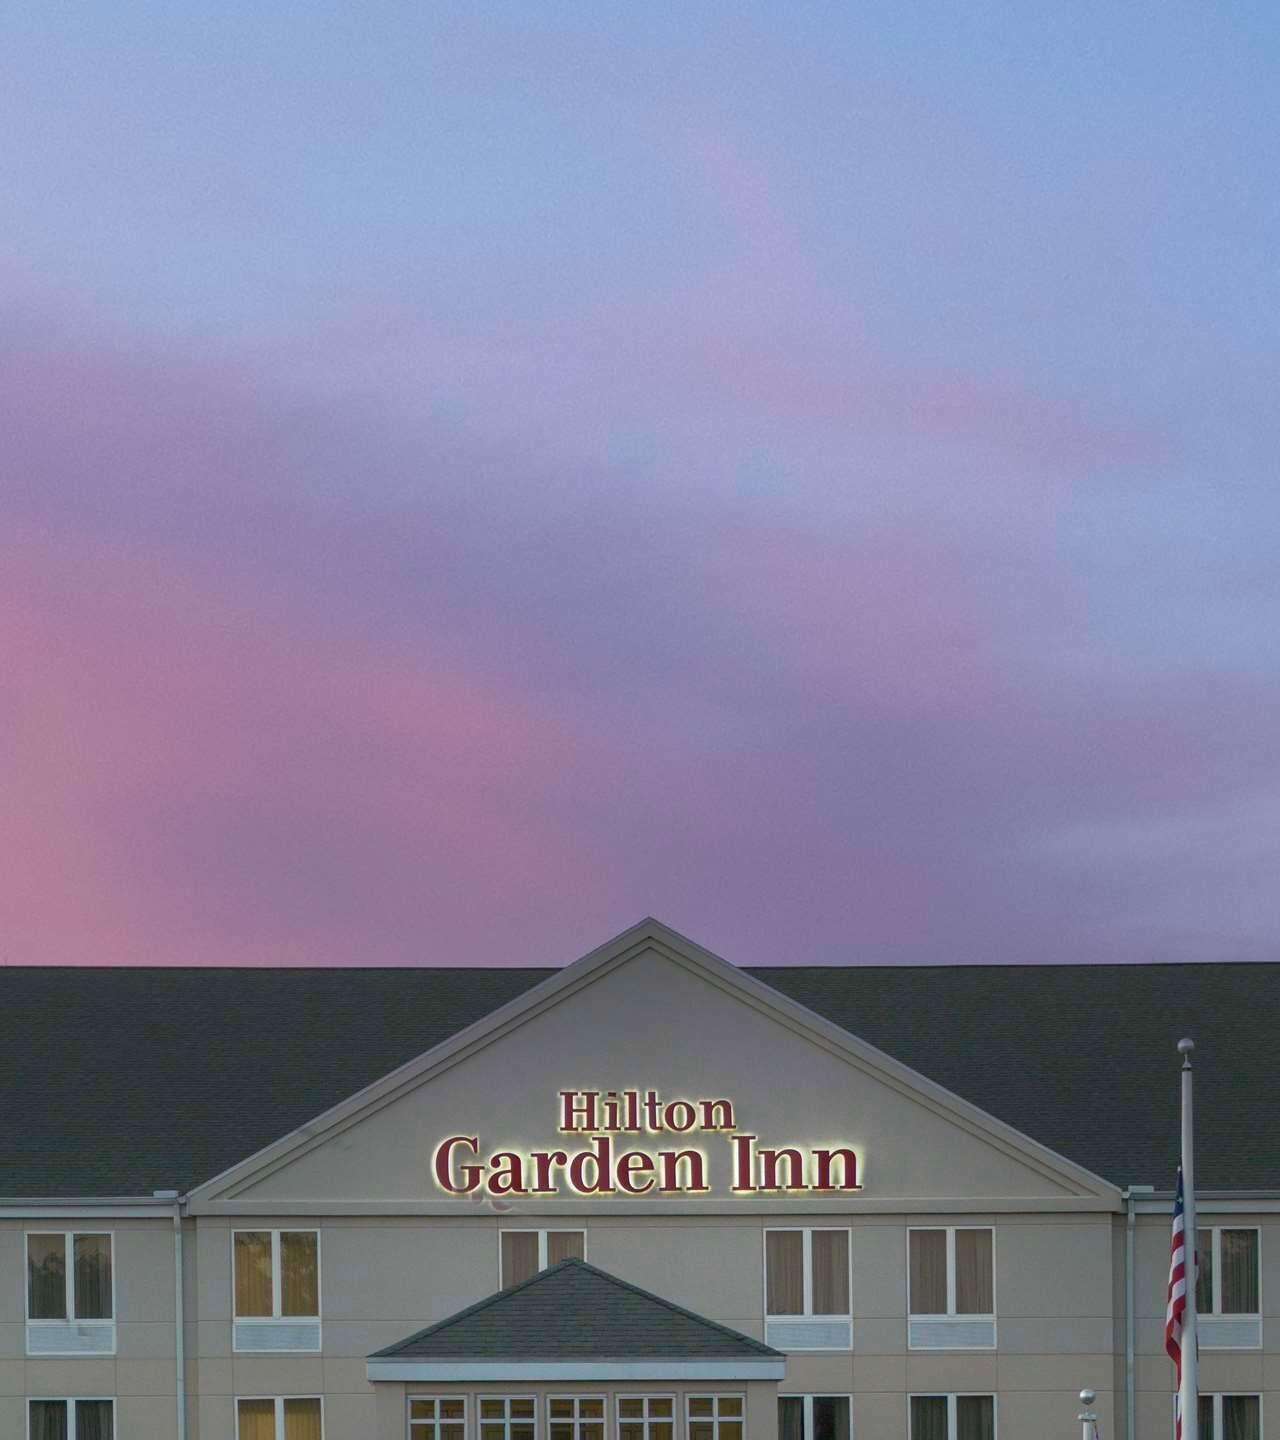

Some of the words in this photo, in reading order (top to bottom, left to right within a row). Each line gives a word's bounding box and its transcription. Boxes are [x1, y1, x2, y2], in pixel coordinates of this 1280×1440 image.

[558, 1090, 738, 1133] Hilton
[434, 1135, 712, 1194] Garden
[730, 1134, 864, 1192] Inn
